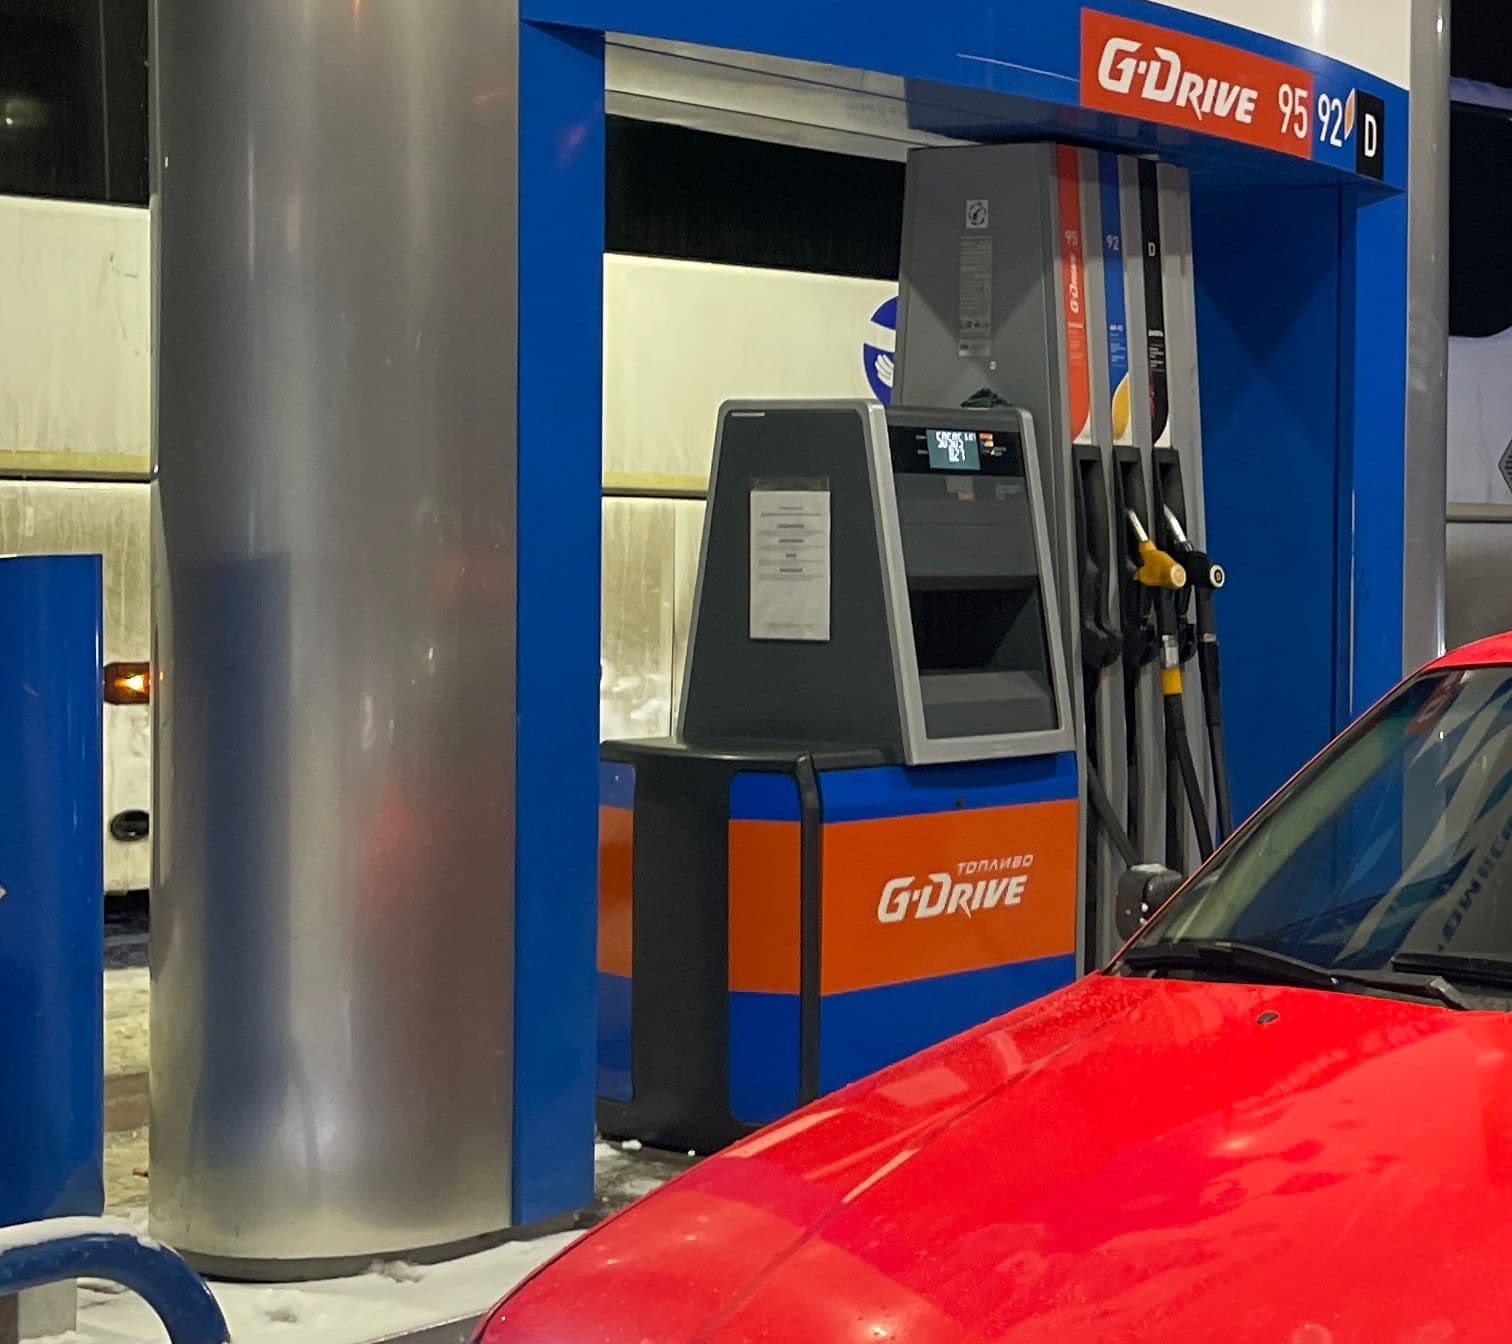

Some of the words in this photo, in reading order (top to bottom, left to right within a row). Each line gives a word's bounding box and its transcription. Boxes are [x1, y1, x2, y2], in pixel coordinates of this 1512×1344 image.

[1278, 83, 1308, 139] 95
[1317, 93, 1343, 147] 92
[1364, 113, 1377, 158] D
[1064, 230, 1078, 246] 95
[1106, 235, 1119, 251] 92
[1148, 242, 1156, 256] D
[956, 855, 1033, 876] ТОПЛИВО
